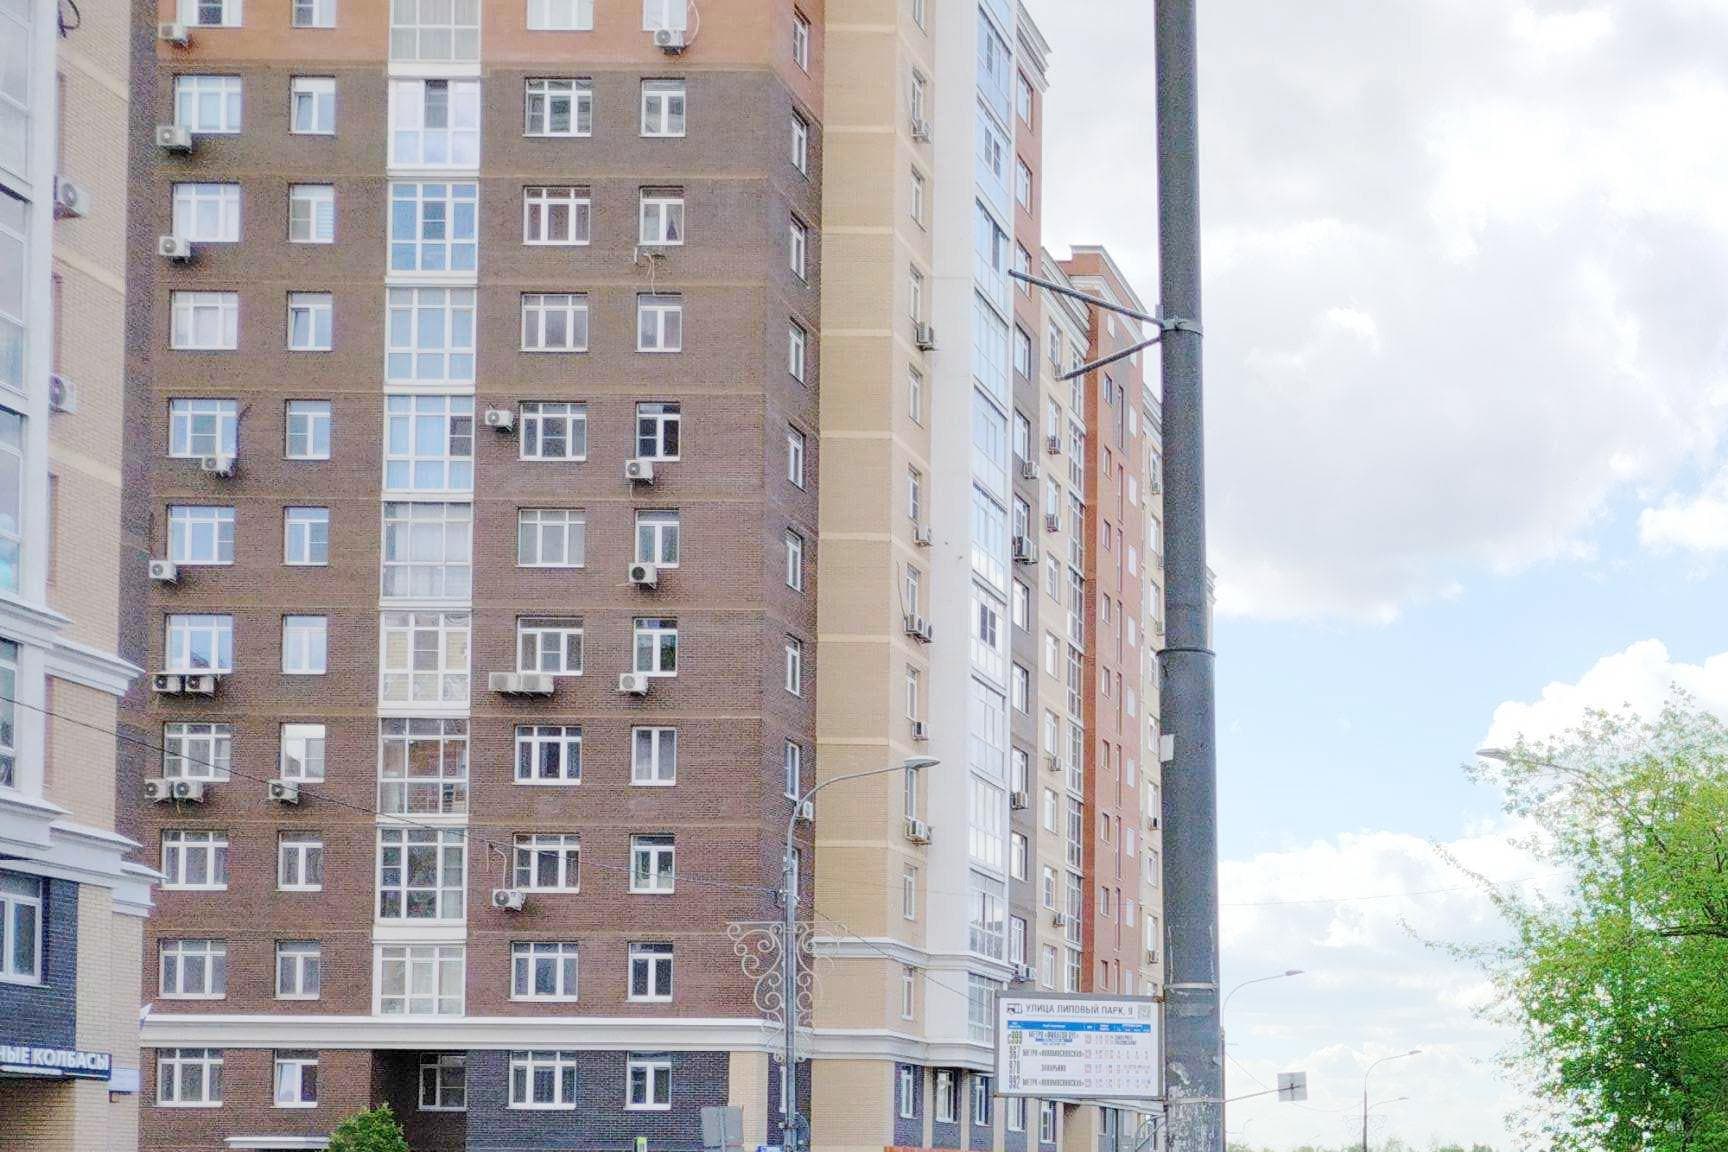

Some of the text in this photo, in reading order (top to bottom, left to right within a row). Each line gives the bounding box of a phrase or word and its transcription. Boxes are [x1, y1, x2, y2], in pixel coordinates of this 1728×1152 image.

[1026, 1003, 1055, 1014] УЛИЦА
[1057, 1004, 1100, 1014] ЛИПОВЫЙ
[31, 1047, 109, 1070] КОЛБАСЫ
